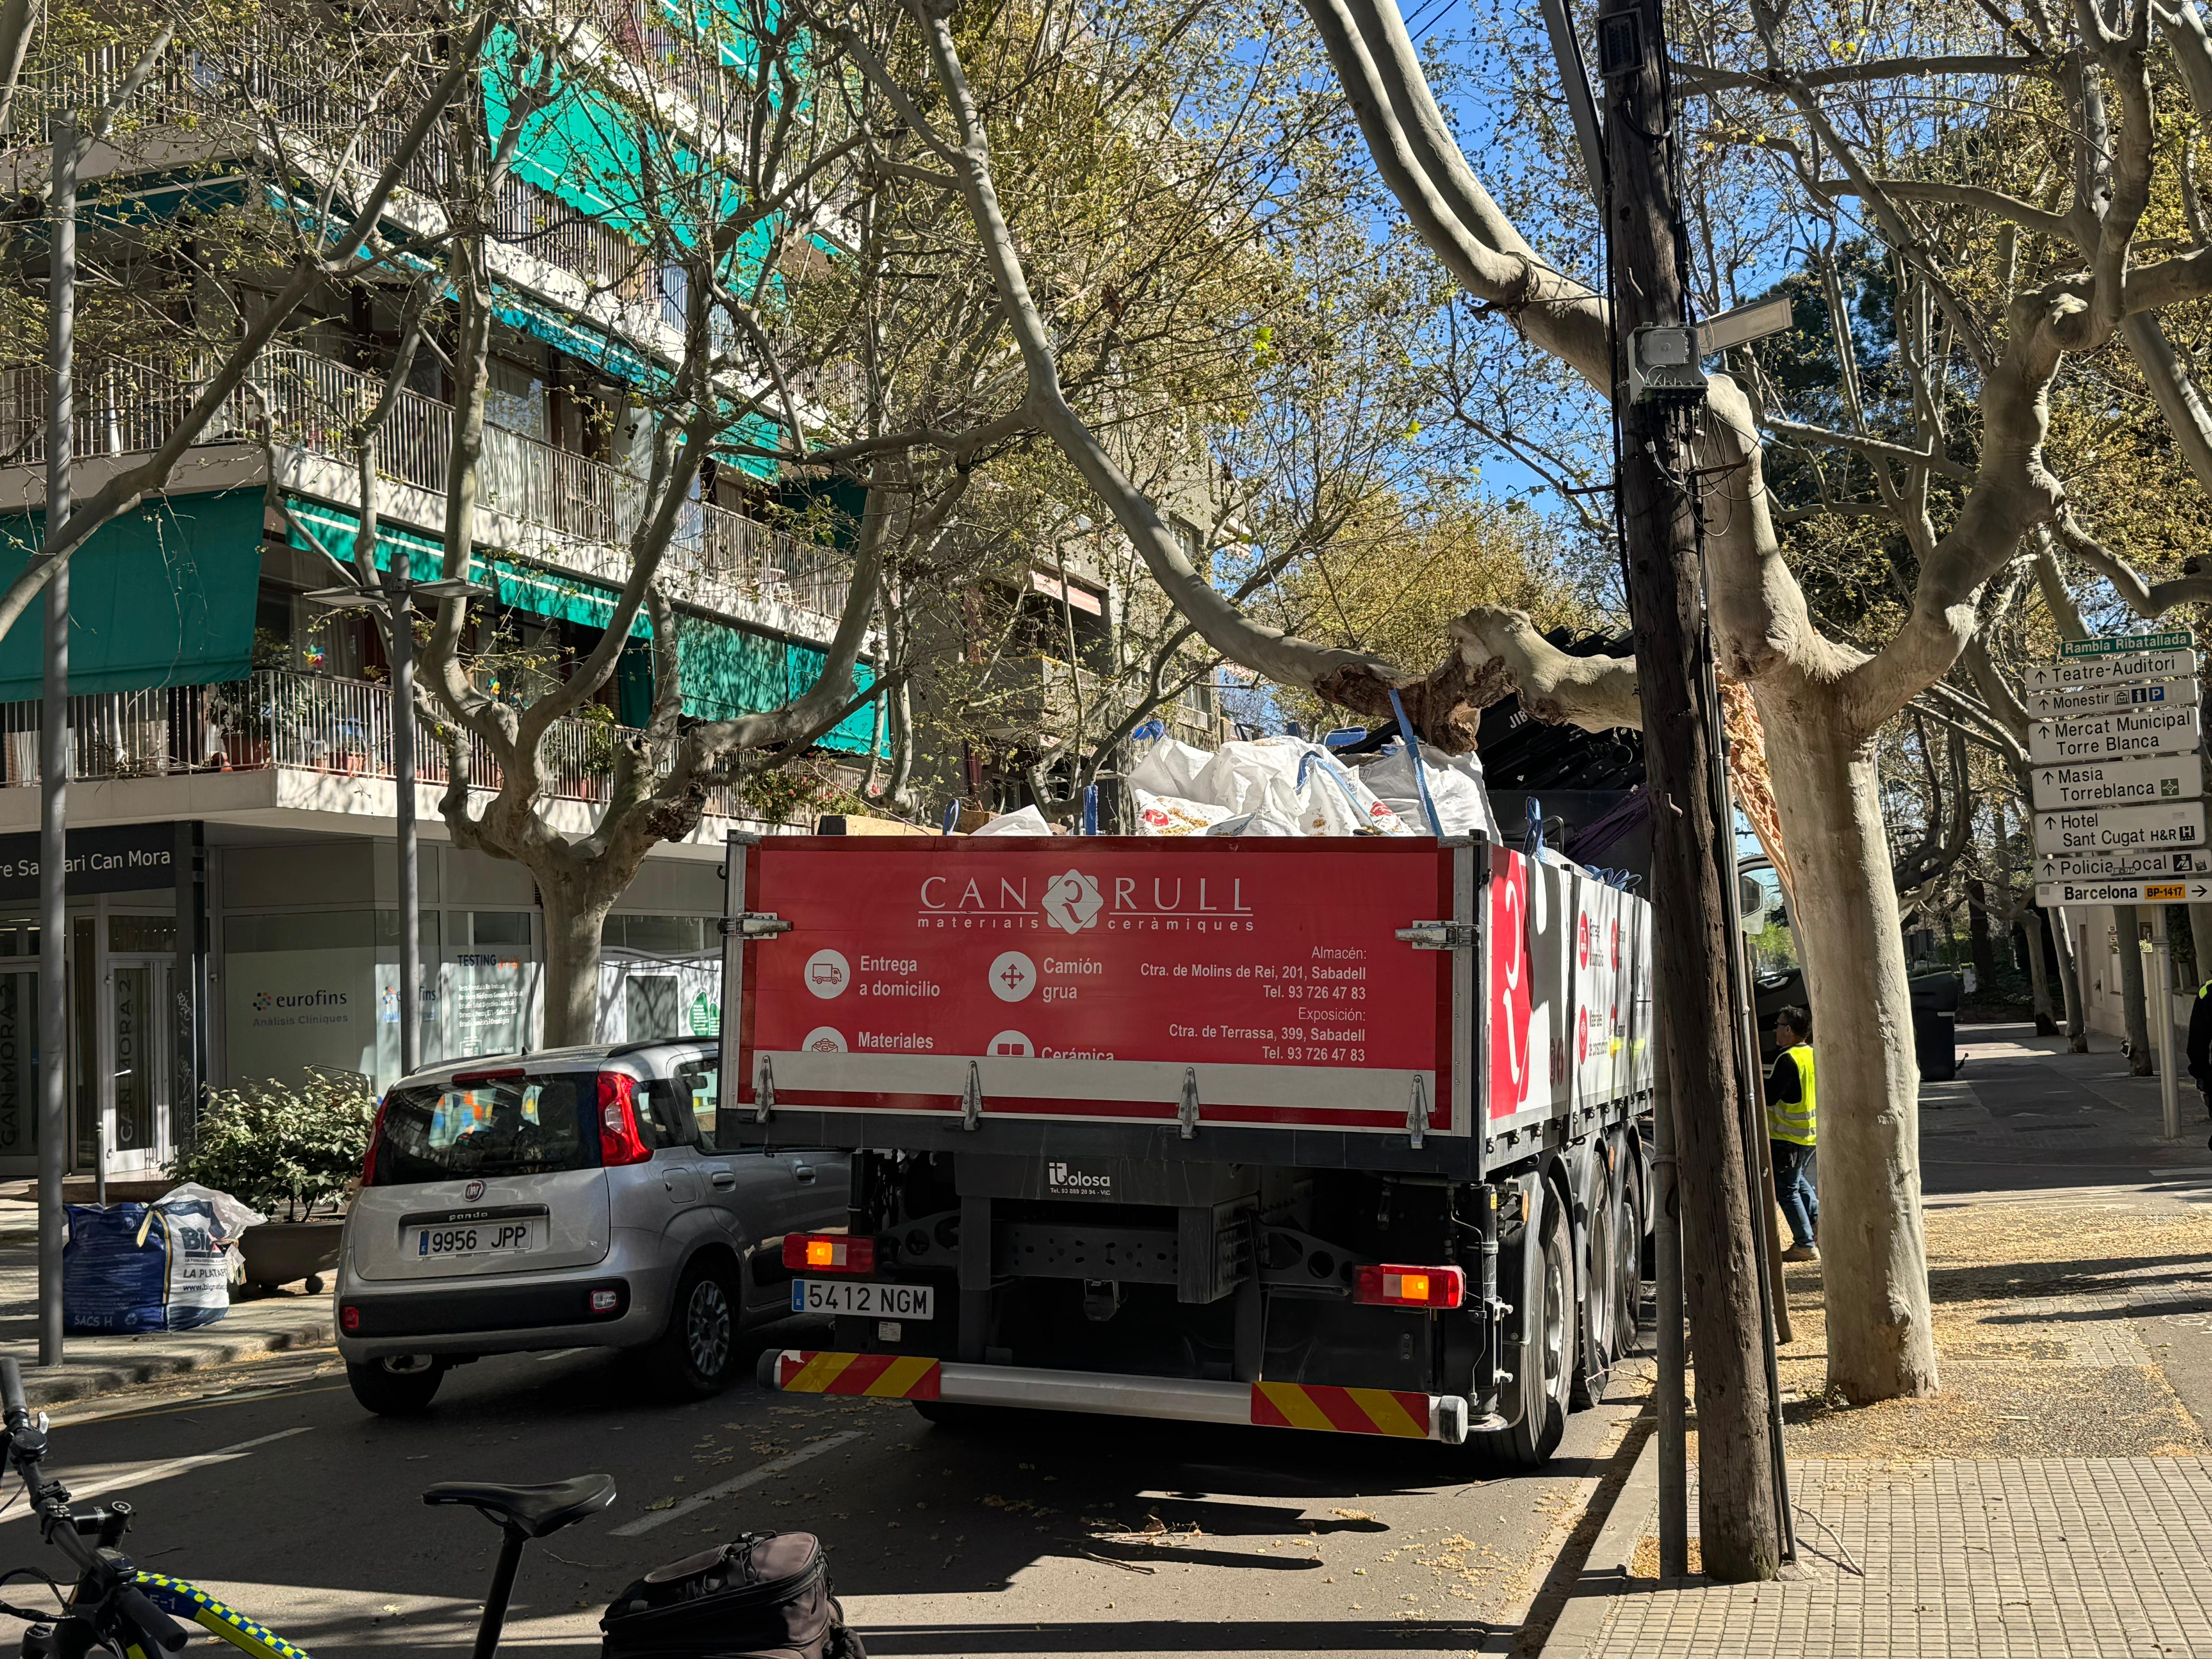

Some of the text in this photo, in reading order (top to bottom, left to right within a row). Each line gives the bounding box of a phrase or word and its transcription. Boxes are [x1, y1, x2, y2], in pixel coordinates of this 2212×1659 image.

[2065, 634, 2187, 654] Rambla Ribatallada
[2052, 655, 2175, 682] Teatre-Auditori
[2053, 692, 2109, 709] Monestir
[2055, 710, 2190, 738] Mercat Municipal
[2056, 735, 2160, 756] Torre Blanca
[2058, 767, 2103, 784] Masia
[2059, 782, 2155, 802] Torreblanca
[2061, 813, 2098, 829] Hotel
[2063, 832, 2096, 847] Sant
[2101, 828, 2145, 847] Cugat
[2150, 829, 2177, 842] H&R
[19, 855, 86, 876] Saari
[91, 853, 123, 870] Can
[129, 850, 171, 867] Mora
[2061, 855, 2167, 875] Policia Local
[920, 877, 1027, 909] CAN
[1115, 877, 1252, 911] RULL
[2064, 885, 2183, 900] Barcelona BP-1417
[917, 915, 1254, 934] materials ceràmiques
[457, 954, 496, 966] TESTING
[1311, 946, 1367, 960] Almacén:
[860, 955, 918, 975] Entrega
[1043, 957, 1103, 975] Camión
[1141, 963, 1366, 981] Ctra. de Molins de Rei, 201, Sabadell
[119, 979, 131, 992] 2
[859, 980, 941, 997] a domicilio
[1042, 986, 1077, 1003] grua
[1263, 985, 1366, 1000] Tel. 93 726 47 83
[276, 990, 347, 1007] eurofins
[253, 1014, 349, 1027] Anàlisis Clíniques
[1298, 1006, 1366, 1023] Exposición:
[858, 1031, 934, 1049] Materiales
[1169, 1023, 1365, 1042] Ctra. de Terrassa, 399, Sabadell
[0, 1004, 15, 1083] MORA
[1041, 1046, 1114, 1061] Cerámica
[1262, 1046, 1365, 1062] Tel. 93 726 47 83
[119, 1089, 133, 1142] CAN
[448, 1211, 488, 1221] panda
[432, 1230, 477, 1252] 9956
[491, 1226, 526, 1248] JPP
[184, 1269, 196, 1278] LA
[808, 1284, 871, 1311] 5412
[880, 1288, 927, 1314] NGM
[73, 1315, 112, 1327] SACS H
